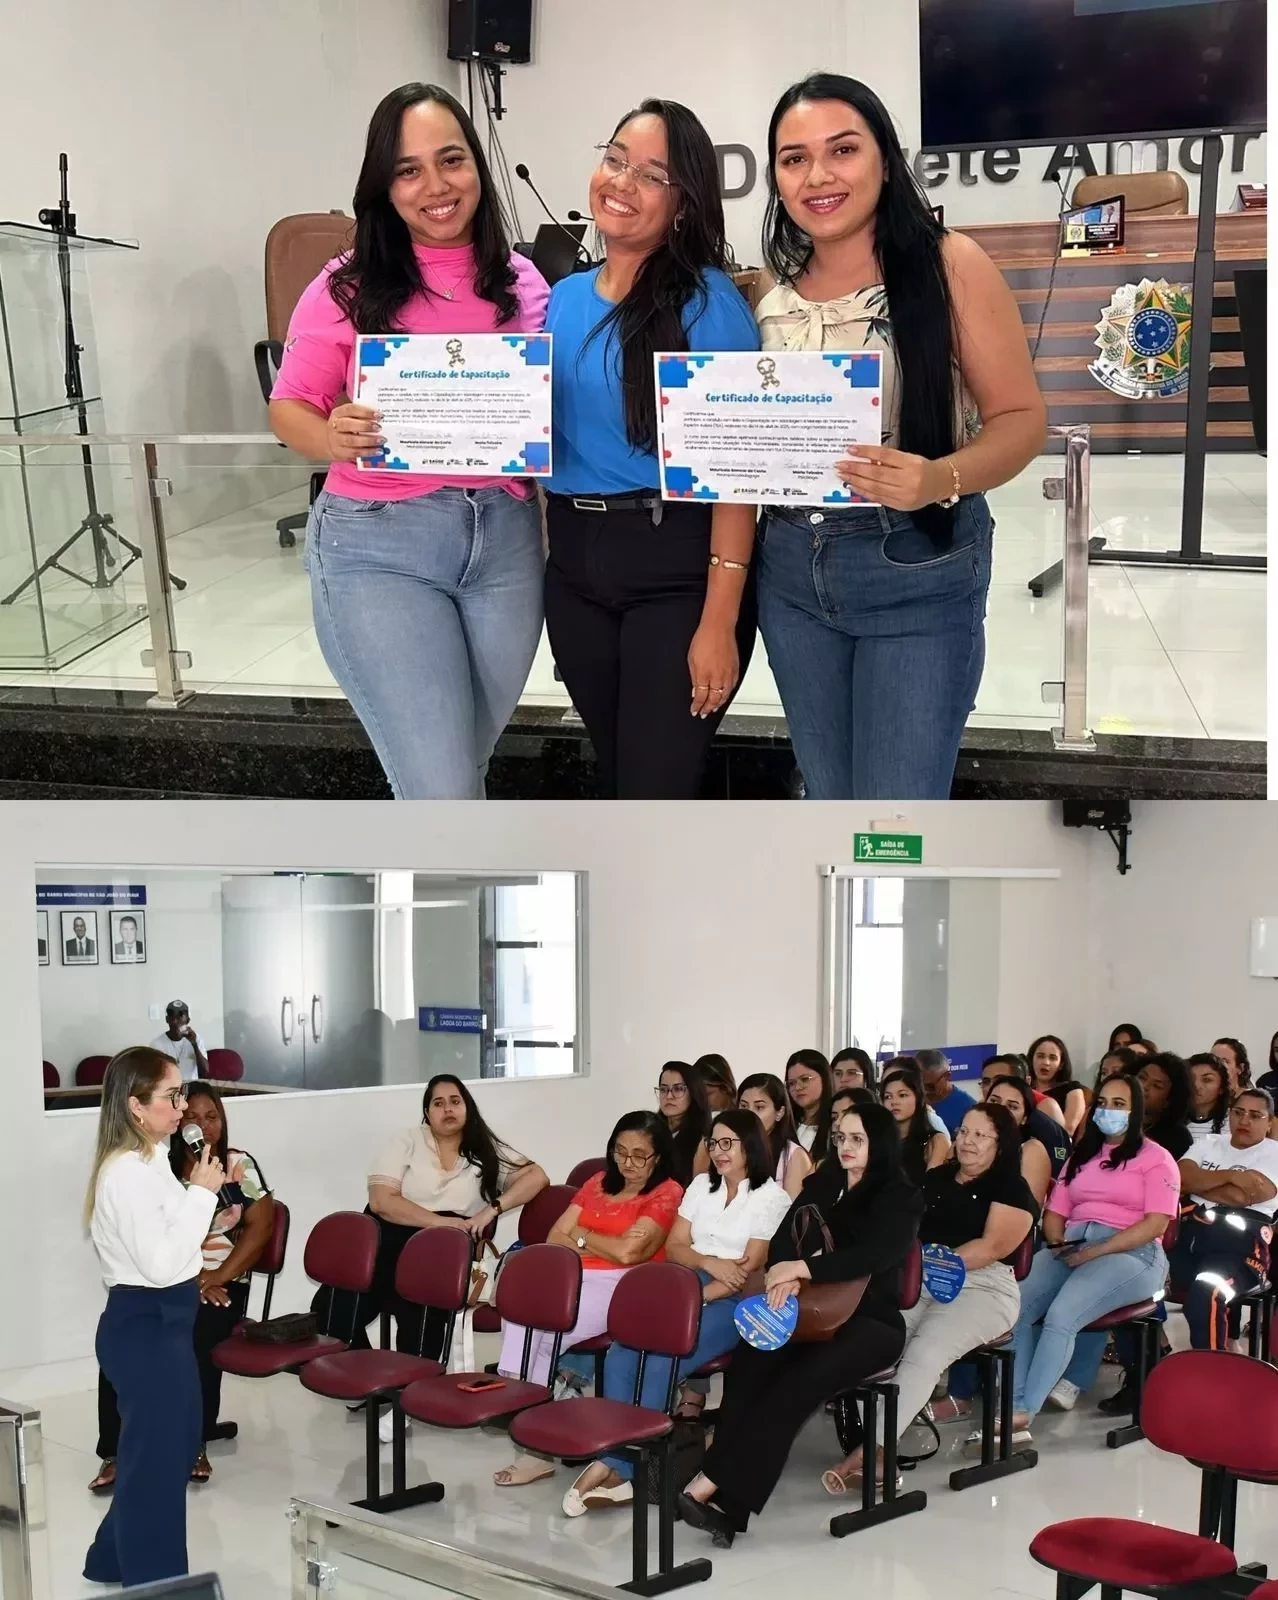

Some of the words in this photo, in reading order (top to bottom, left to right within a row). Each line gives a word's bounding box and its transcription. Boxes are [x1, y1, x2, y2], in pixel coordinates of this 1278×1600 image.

[400, 369, 447, 379] Certificado
[449, 370, 458, 379] de
[461, 369, 511, 380] Capacitação
[705, 392, 759, 403] Certificado
[762, 392, 773, 403] de
[775, 392, 833, 405] Capacitação
[880, 840, 896, 848] SAÍDA
[875, 848, 910, 856] EMERGÊNCIA
